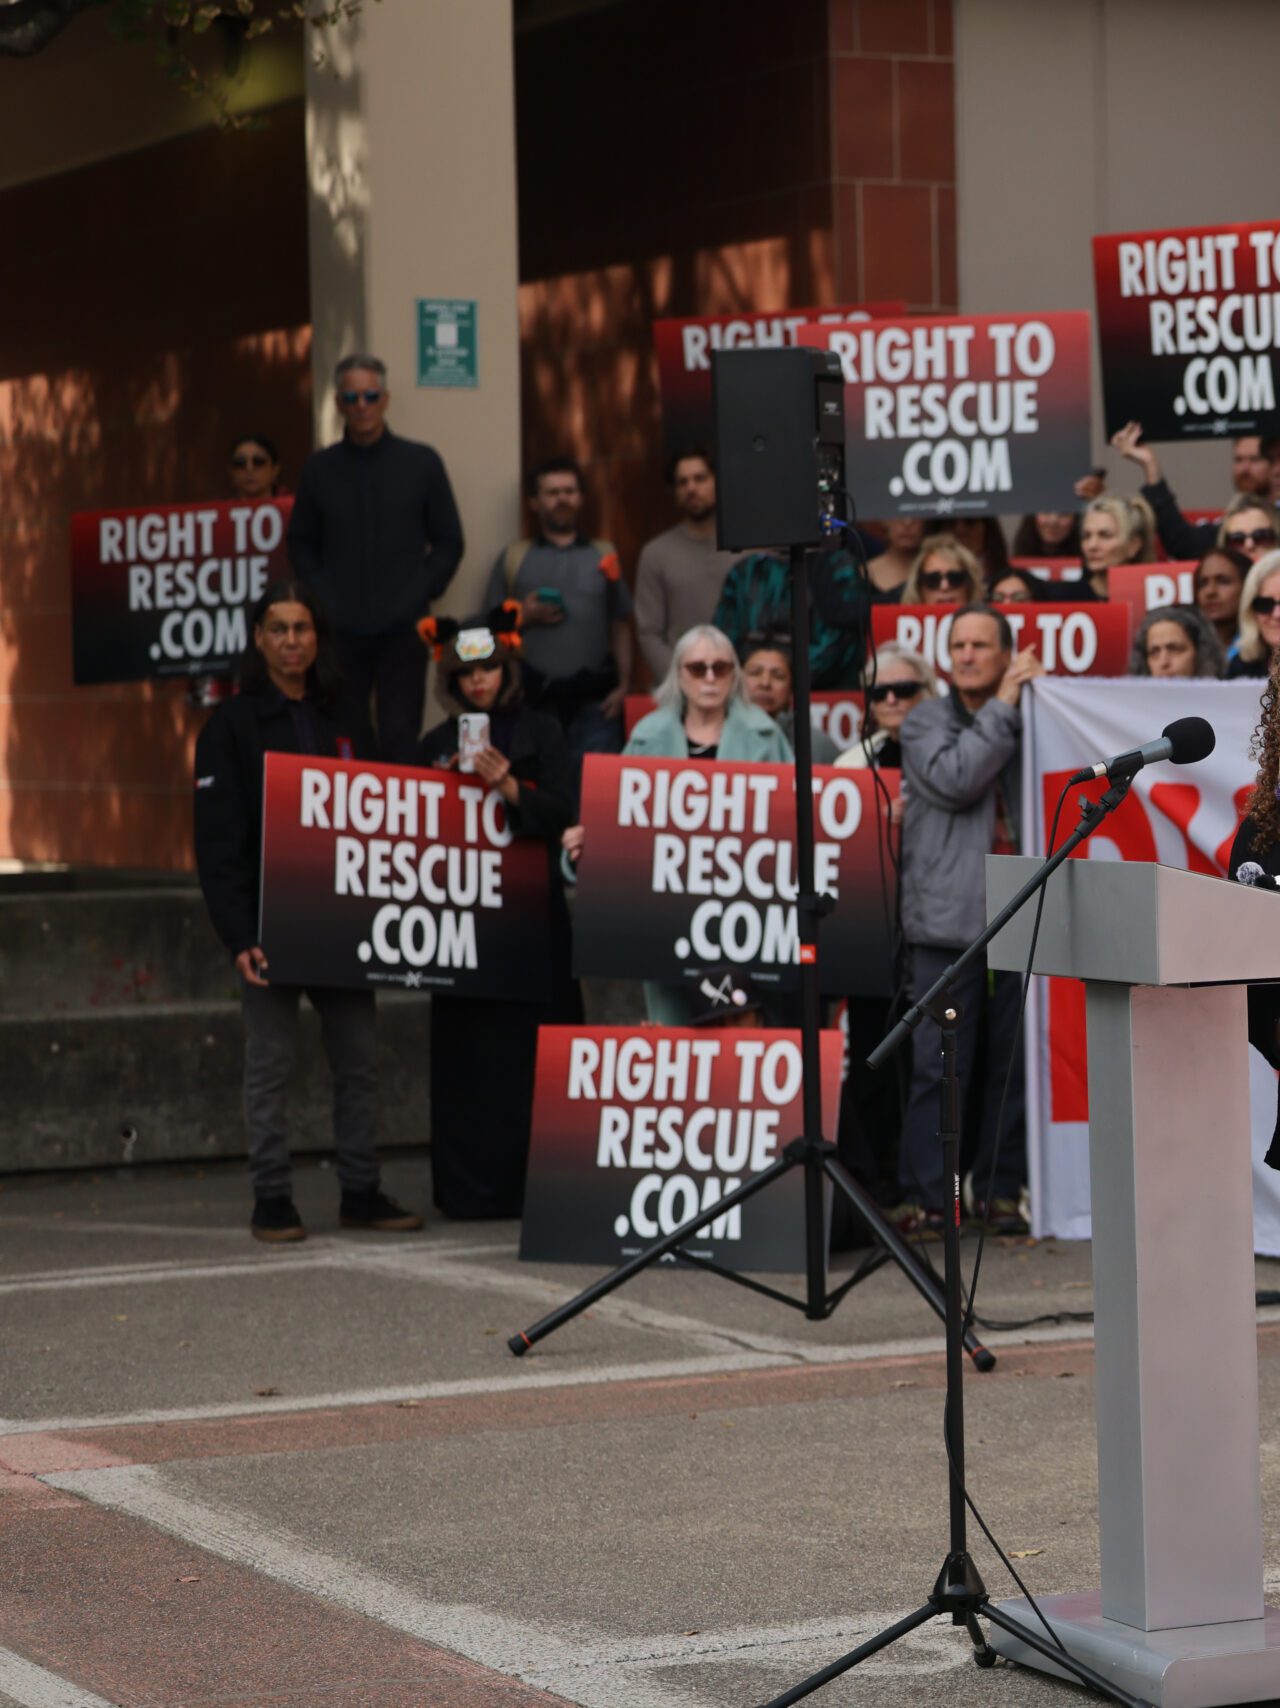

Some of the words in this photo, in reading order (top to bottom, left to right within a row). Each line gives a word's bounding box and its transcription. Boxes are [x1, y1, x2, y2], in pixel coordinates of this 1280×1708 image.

[1118, 234, 1239, 297] RIGHT
[829, 326, 976, 383] RIGHT
[987, 321, 1055, 377] TO
[864, 379, 1039, 440] RESCUE
[1173, 355, 1276, 416] .COM
[888, 438, 1013, 496] .COM
[100, 510, 218, 564] RIGHT
[229, 504, 282, 552] TO
[129, 556, 269, 611] RESCUE
[150, 607, 247, 660] .COM
[1037, 612, 1097, 673] TO
[301, 767, 445, 840] RIGHT
[459, 785, 513, 848] TO
[618, 767, 777, 834] RIGHT
[335, 835, 503, 909] RESCUE
[357, 903, 478, 969] .COM
[674, 899, 800, 965] .COM
[568, 1037, 721, 1102] RIGHT
[735, 1039, 803, 1106] TO
[597, 1105, 781, 1173] RESCUE
[614, 1173, 742, 1241] .COM
